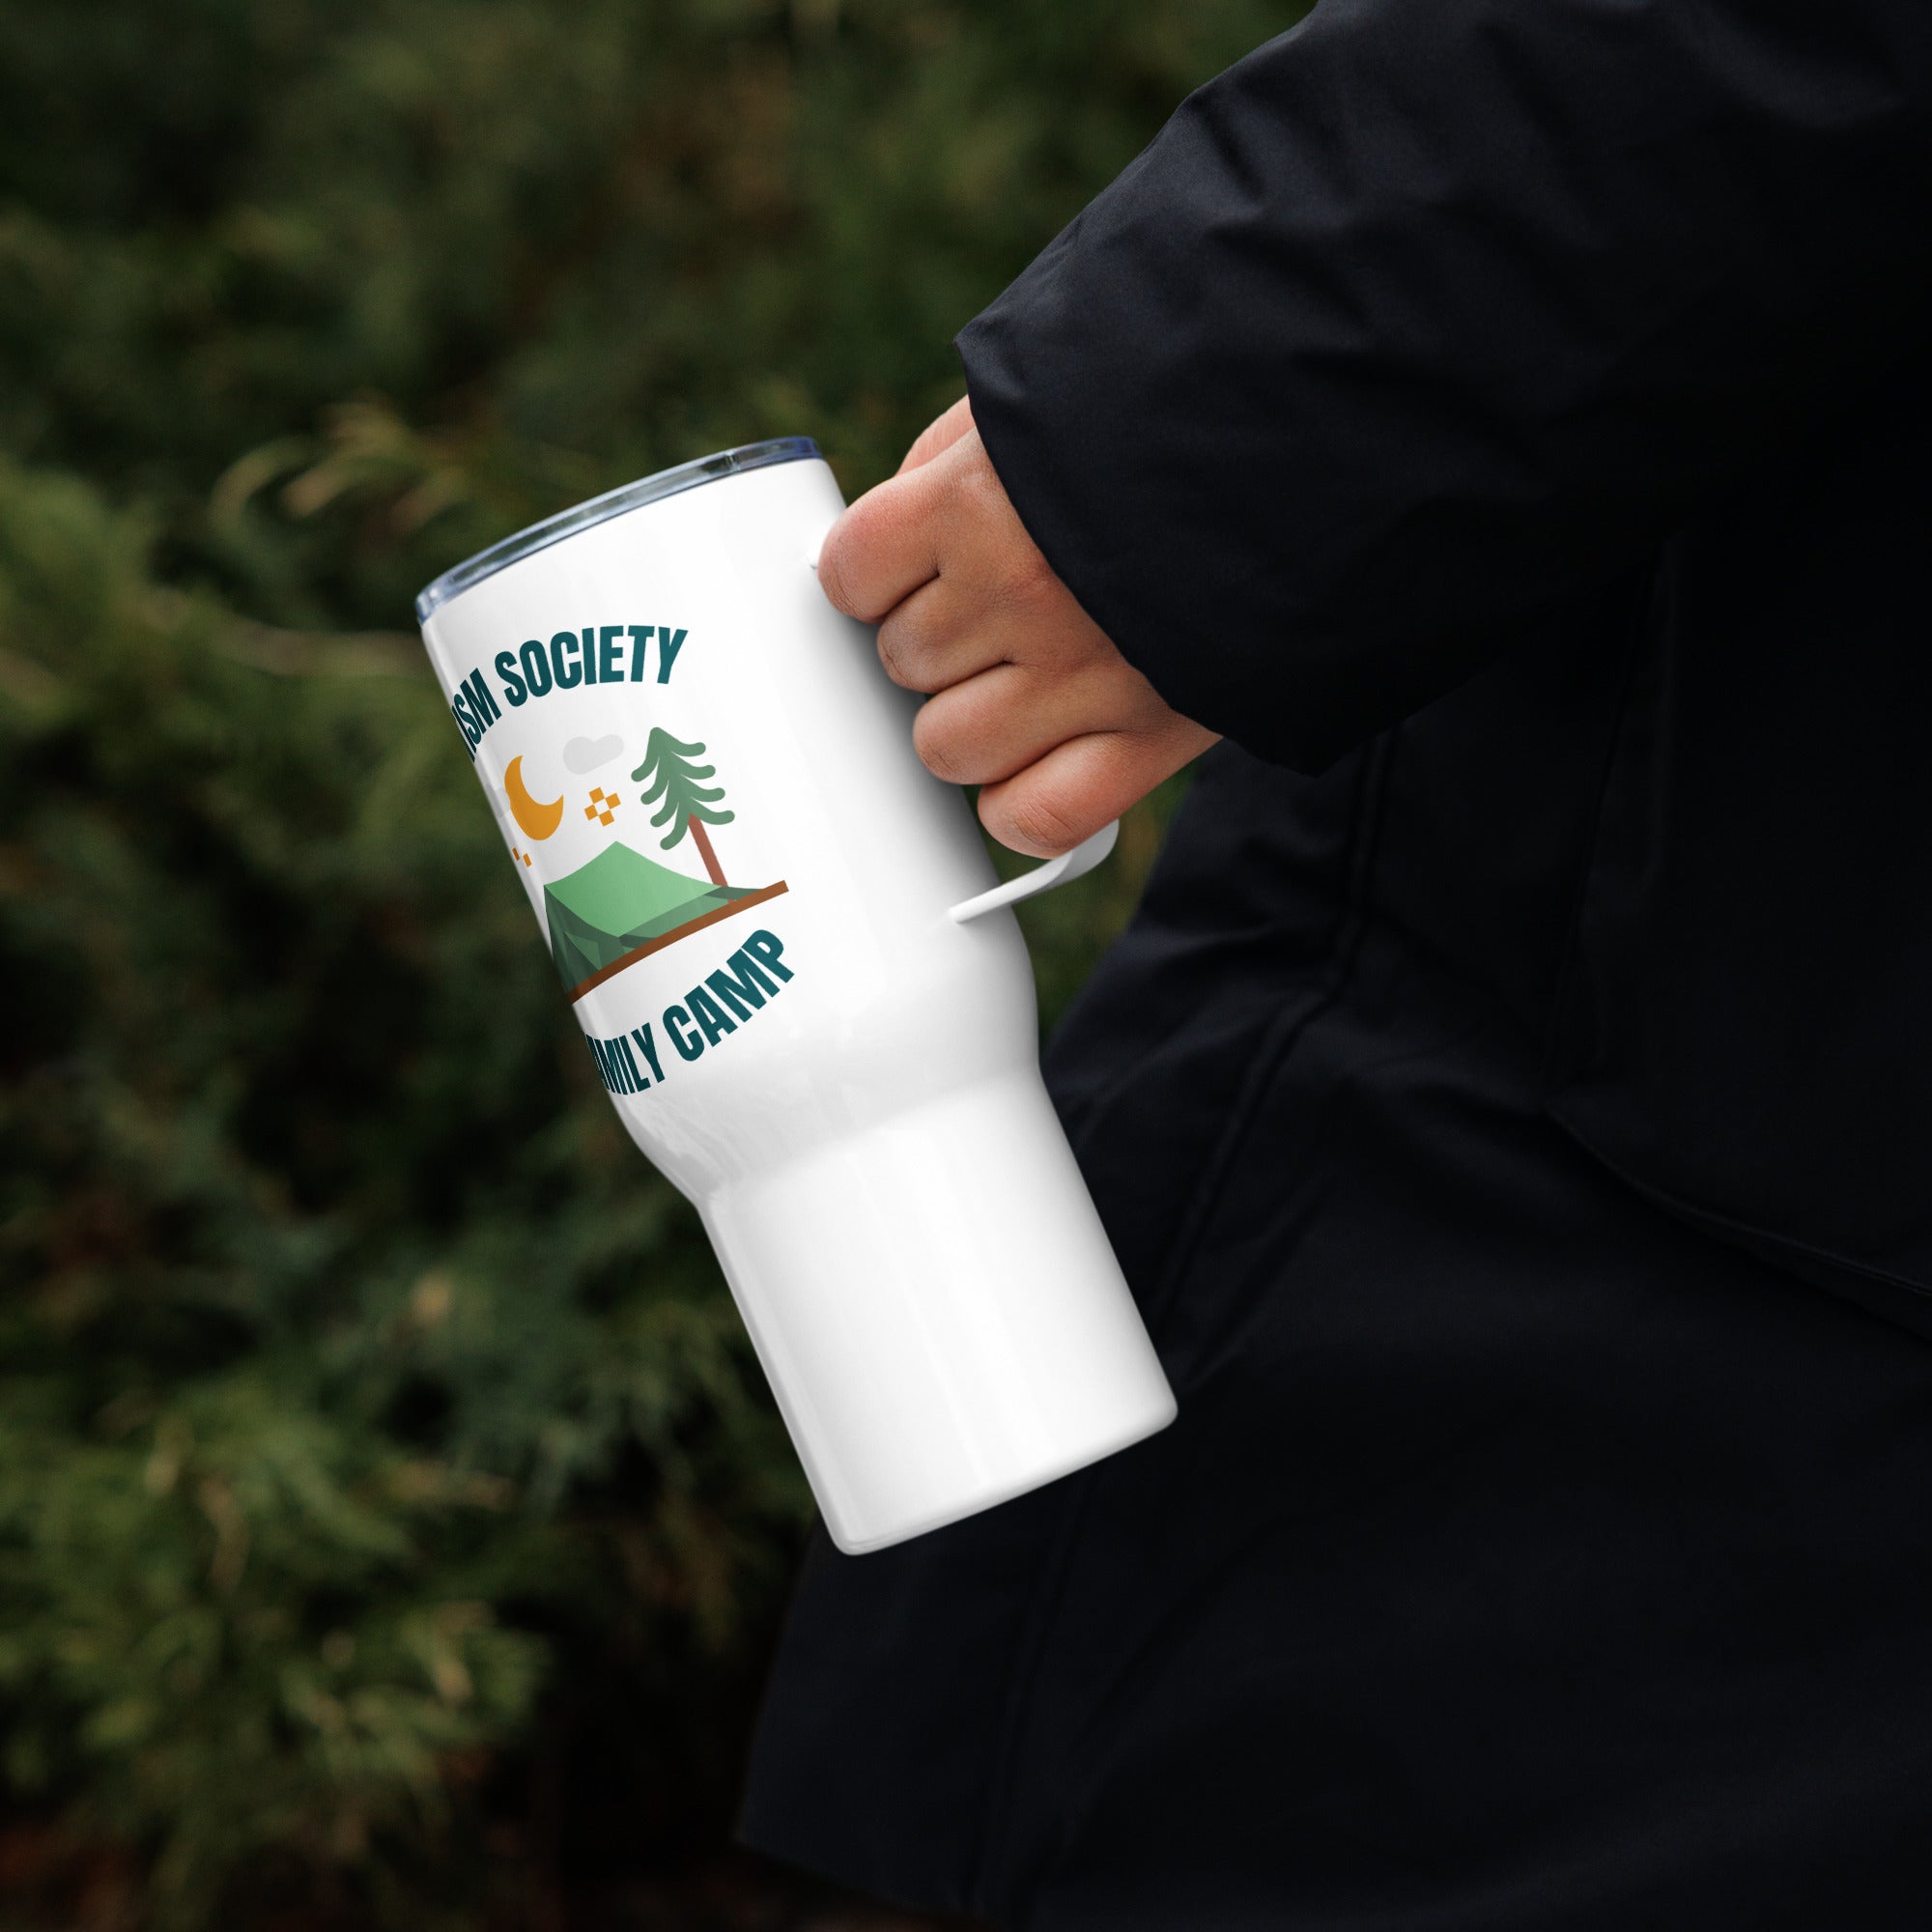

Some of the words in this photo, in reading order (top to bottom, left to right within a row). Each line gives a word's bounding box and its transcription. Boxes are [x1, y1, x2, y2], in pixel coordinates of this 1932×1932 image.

[451, 668, 502, 763] ISM
[495, 625, 689, 707] SOCIETY
[663, 929, 795, 1062] CAMP
